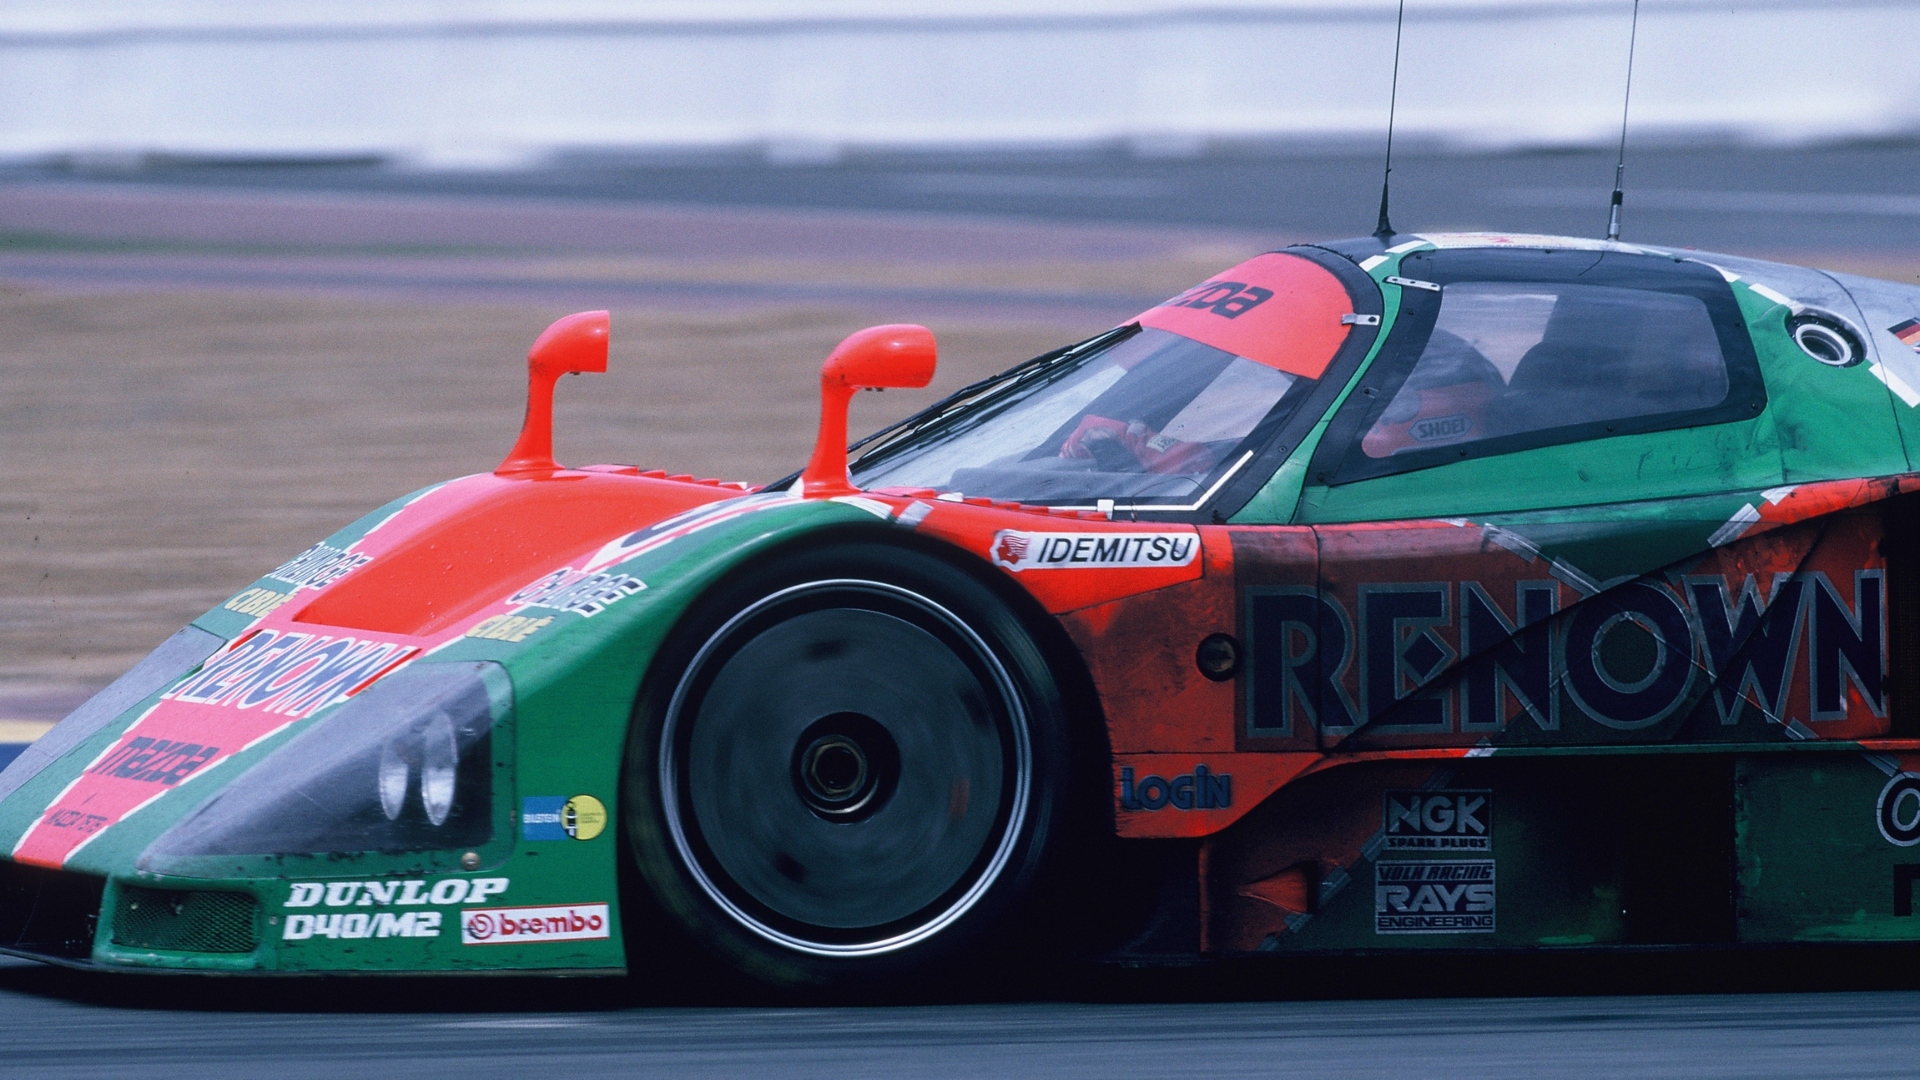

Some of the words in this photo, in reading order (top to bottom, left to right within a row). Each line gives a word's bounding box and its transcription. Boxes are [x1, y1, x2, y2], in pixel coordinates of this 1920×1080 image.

[1418, 419, 1465, 438] SHOEI
[1037, 537, 1192, 562] IDEMITSU
[1244, 569, 1887, 738] RENOWN
[160, 629, 419, 717] RENOWN
[1388, 795, 1486, 834] NGK
[1389, 837, 1437, 848] SPARK
[1441, 837, 1487, 848] PLUGS
[1378, 866, 1424, 881] VOLK
[1427, 865, 1493, 880] RACING
[284, 878, 509, 907] DUNLOP
[1377, 884, 1494, 912] RAYS
[283, 911, 442, 940] D40/M2
[500, 910, 602, 936] brembo
[1377, 916, 1494, 928] ENGINEERING
